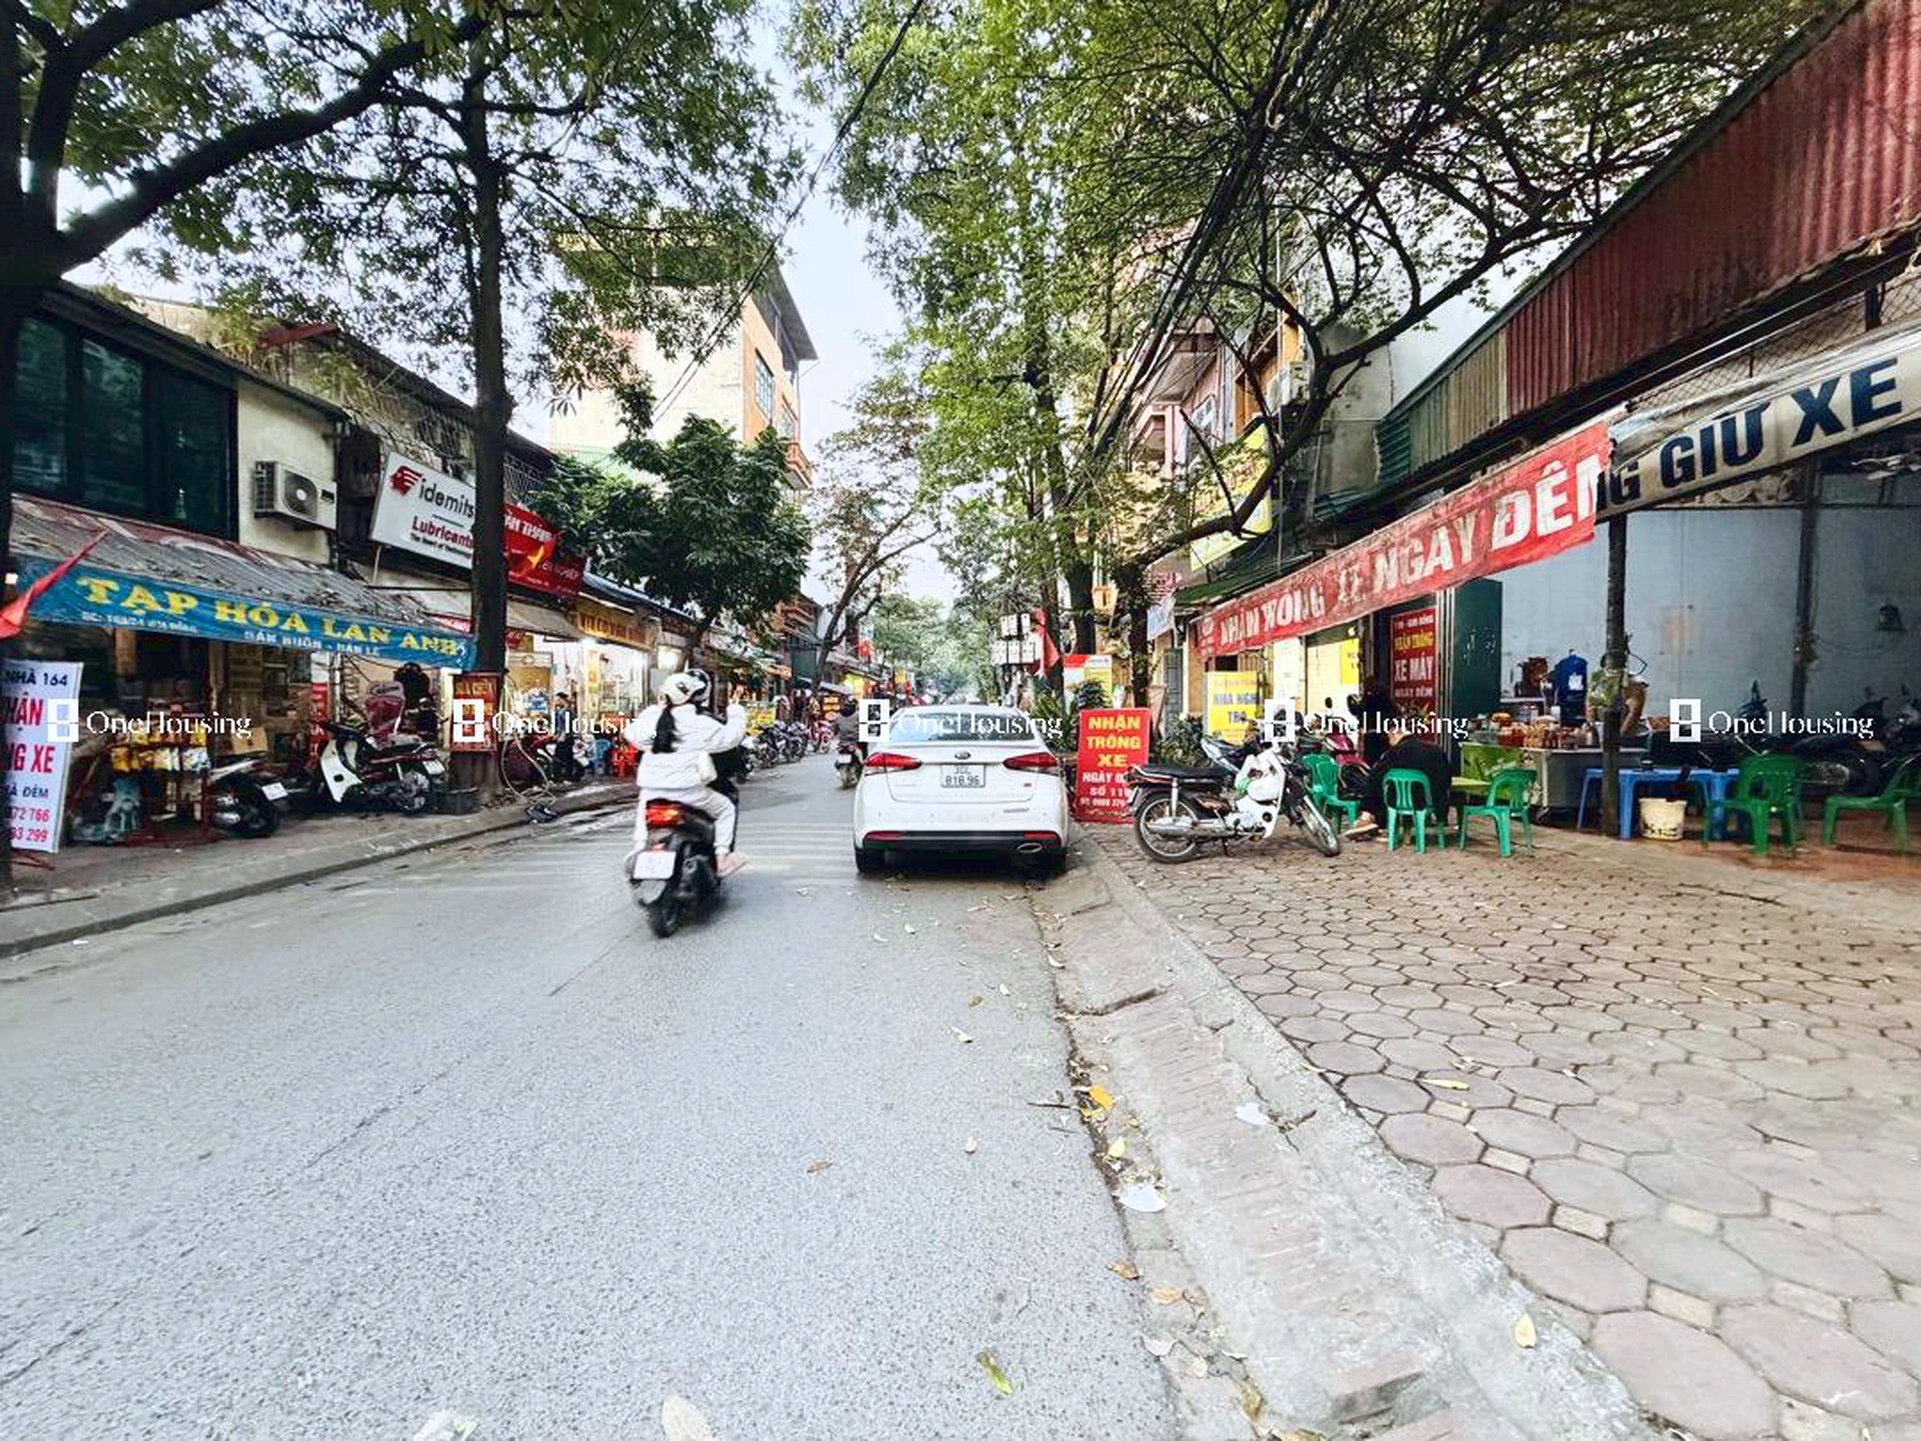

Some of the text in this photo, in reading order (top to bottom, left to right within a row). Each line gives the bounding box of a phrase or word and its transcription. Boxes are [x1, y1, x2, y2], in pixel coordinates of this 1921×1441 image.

[1790, 357, 1902, 447] XE
[418, 478, 475, 519] idemits
[76, 575, 198, 616] TẠP
[214, 600, 310, 634] HÓA
[322, 616, 392, 645] LAN
[43, 672, 68, 686] 164
[1394, 651, 1434, 682] XE MÁY
[1088, 714, 1140, 732] NHẬN
[1086, 733, 1141, 749] TRÔNG
[30, 744, 56, 773] XE
[1096, 753, 1129, 768] XE
